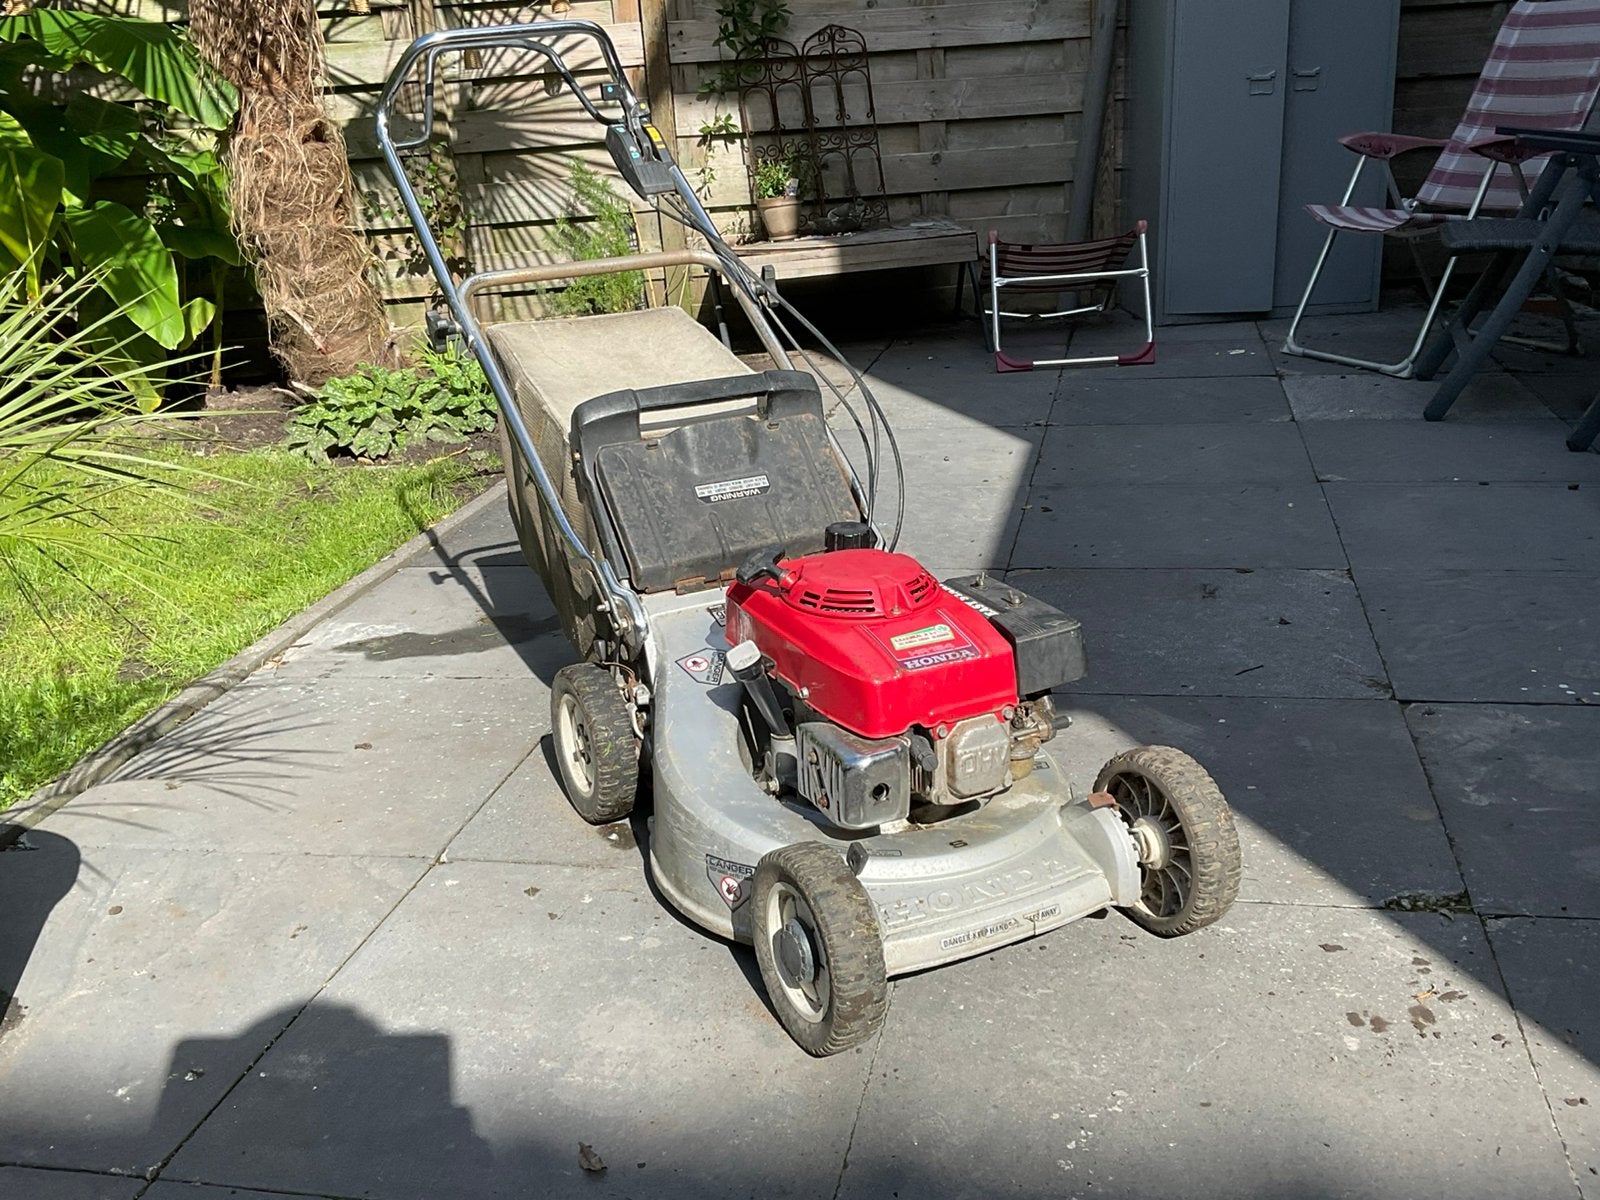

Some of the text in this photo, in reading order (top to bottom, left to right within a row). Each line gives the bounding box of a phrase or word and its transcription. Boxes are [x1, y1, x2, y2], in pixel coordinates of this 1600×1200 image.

[710, 488, 761, 502] WARNING
[711, 652, 725, 683] DANGER
[904, 649, 975, 669] HONDA
[709, 857, 754, 876] DANGER
[880, 857, 1082, 926] HONDA
[1041, 907, 1057, 920] AWAY
